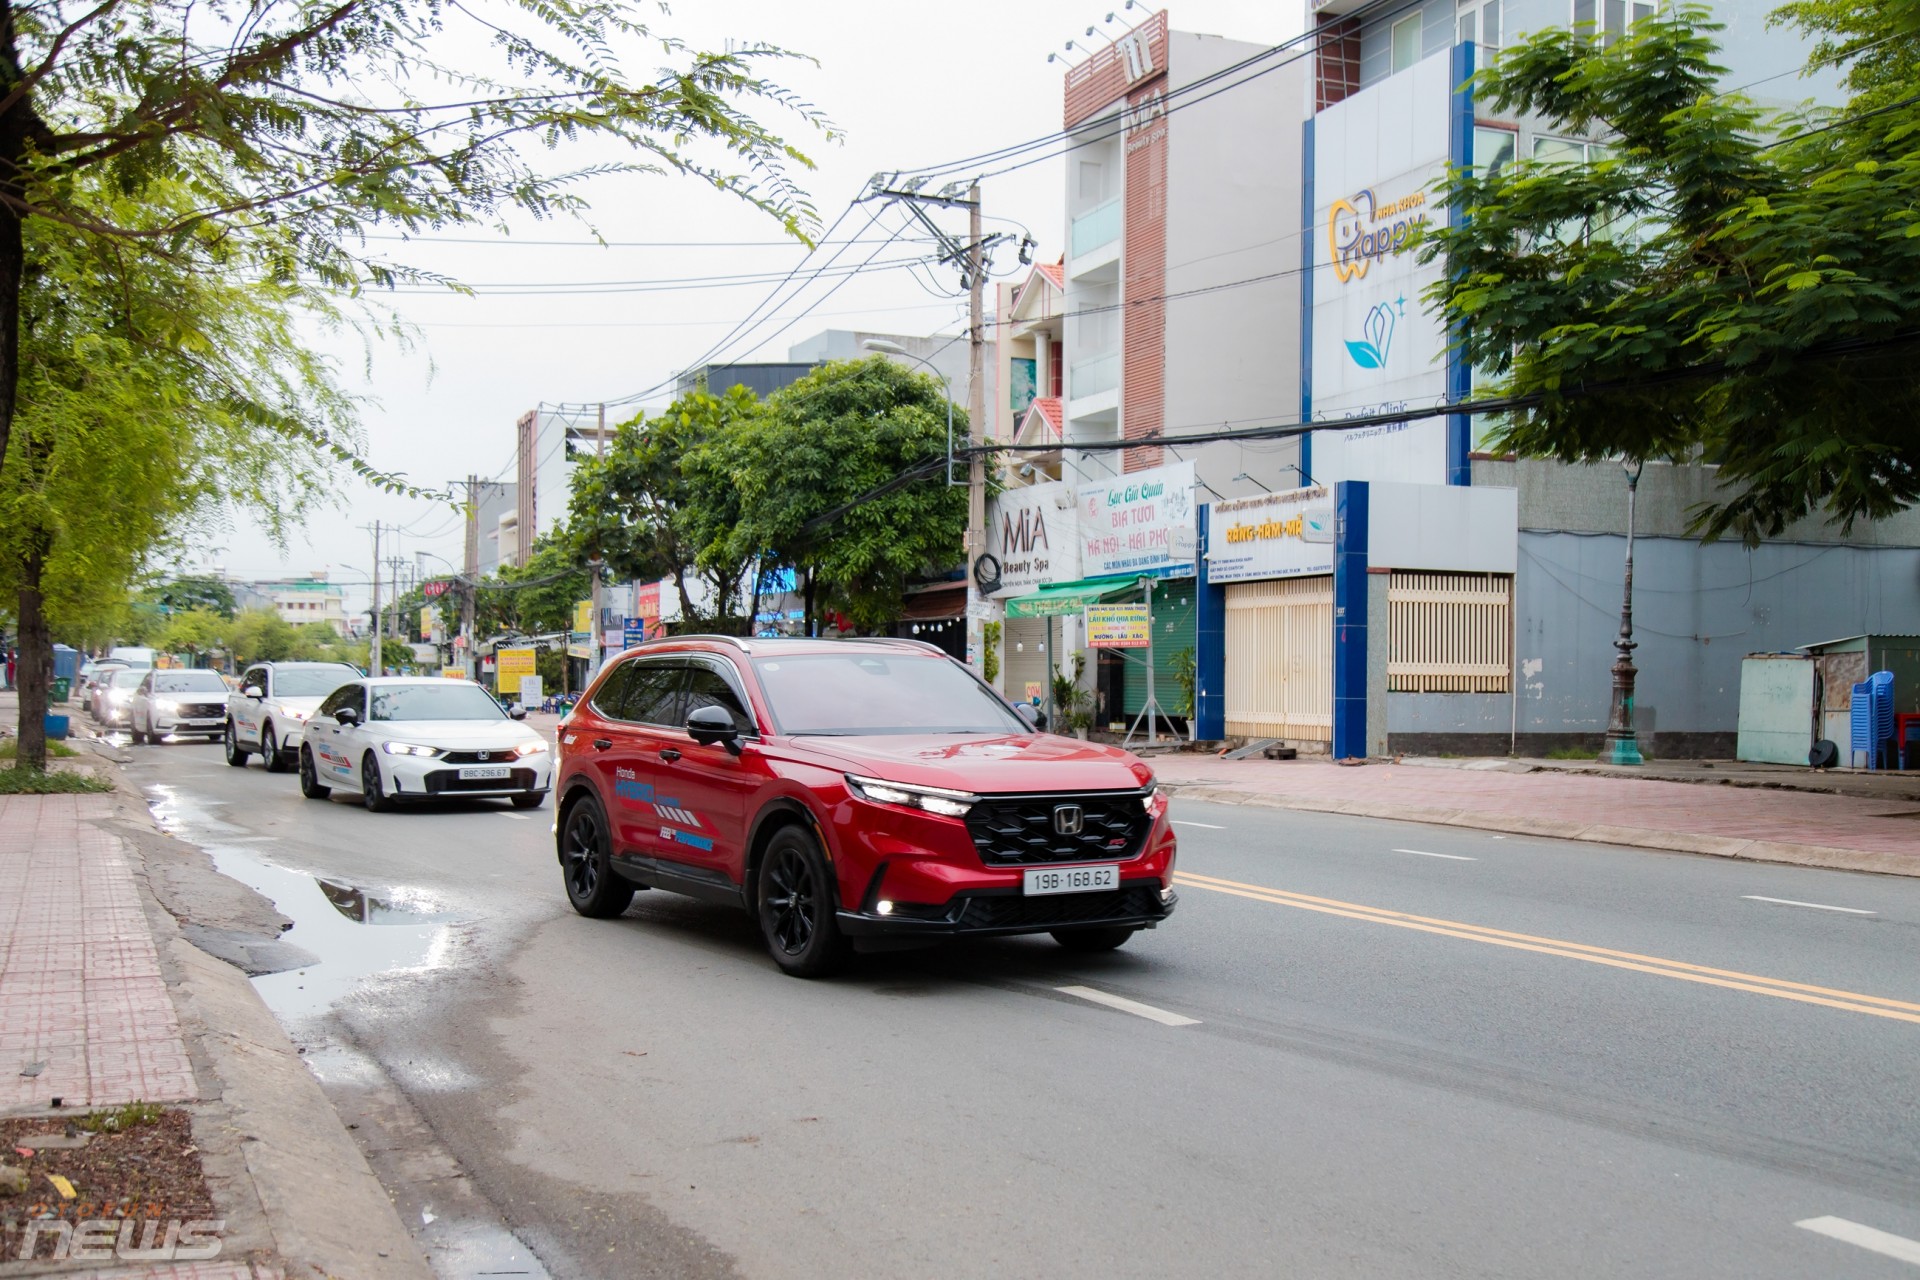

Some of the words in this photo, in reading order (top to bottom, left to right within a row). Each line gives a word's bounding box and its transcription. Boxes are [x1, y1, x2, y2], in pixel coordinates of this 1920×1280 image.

[1376, 202, 1397, 220] NHA
[1398, 191, 1425, 212] KHOA
[1111, 510, 1128, 528] BIA
[1087, 535, 1101, 557] HÀ
[1003, 560, 1031, 575] Beauty
[1034, 557, 1049, 572] Spa
[616, 765, 636, 779] Honda
[615, 778, 655, 804] HYBRID
[1034, 870, 1112, 890] 19B-168.62
